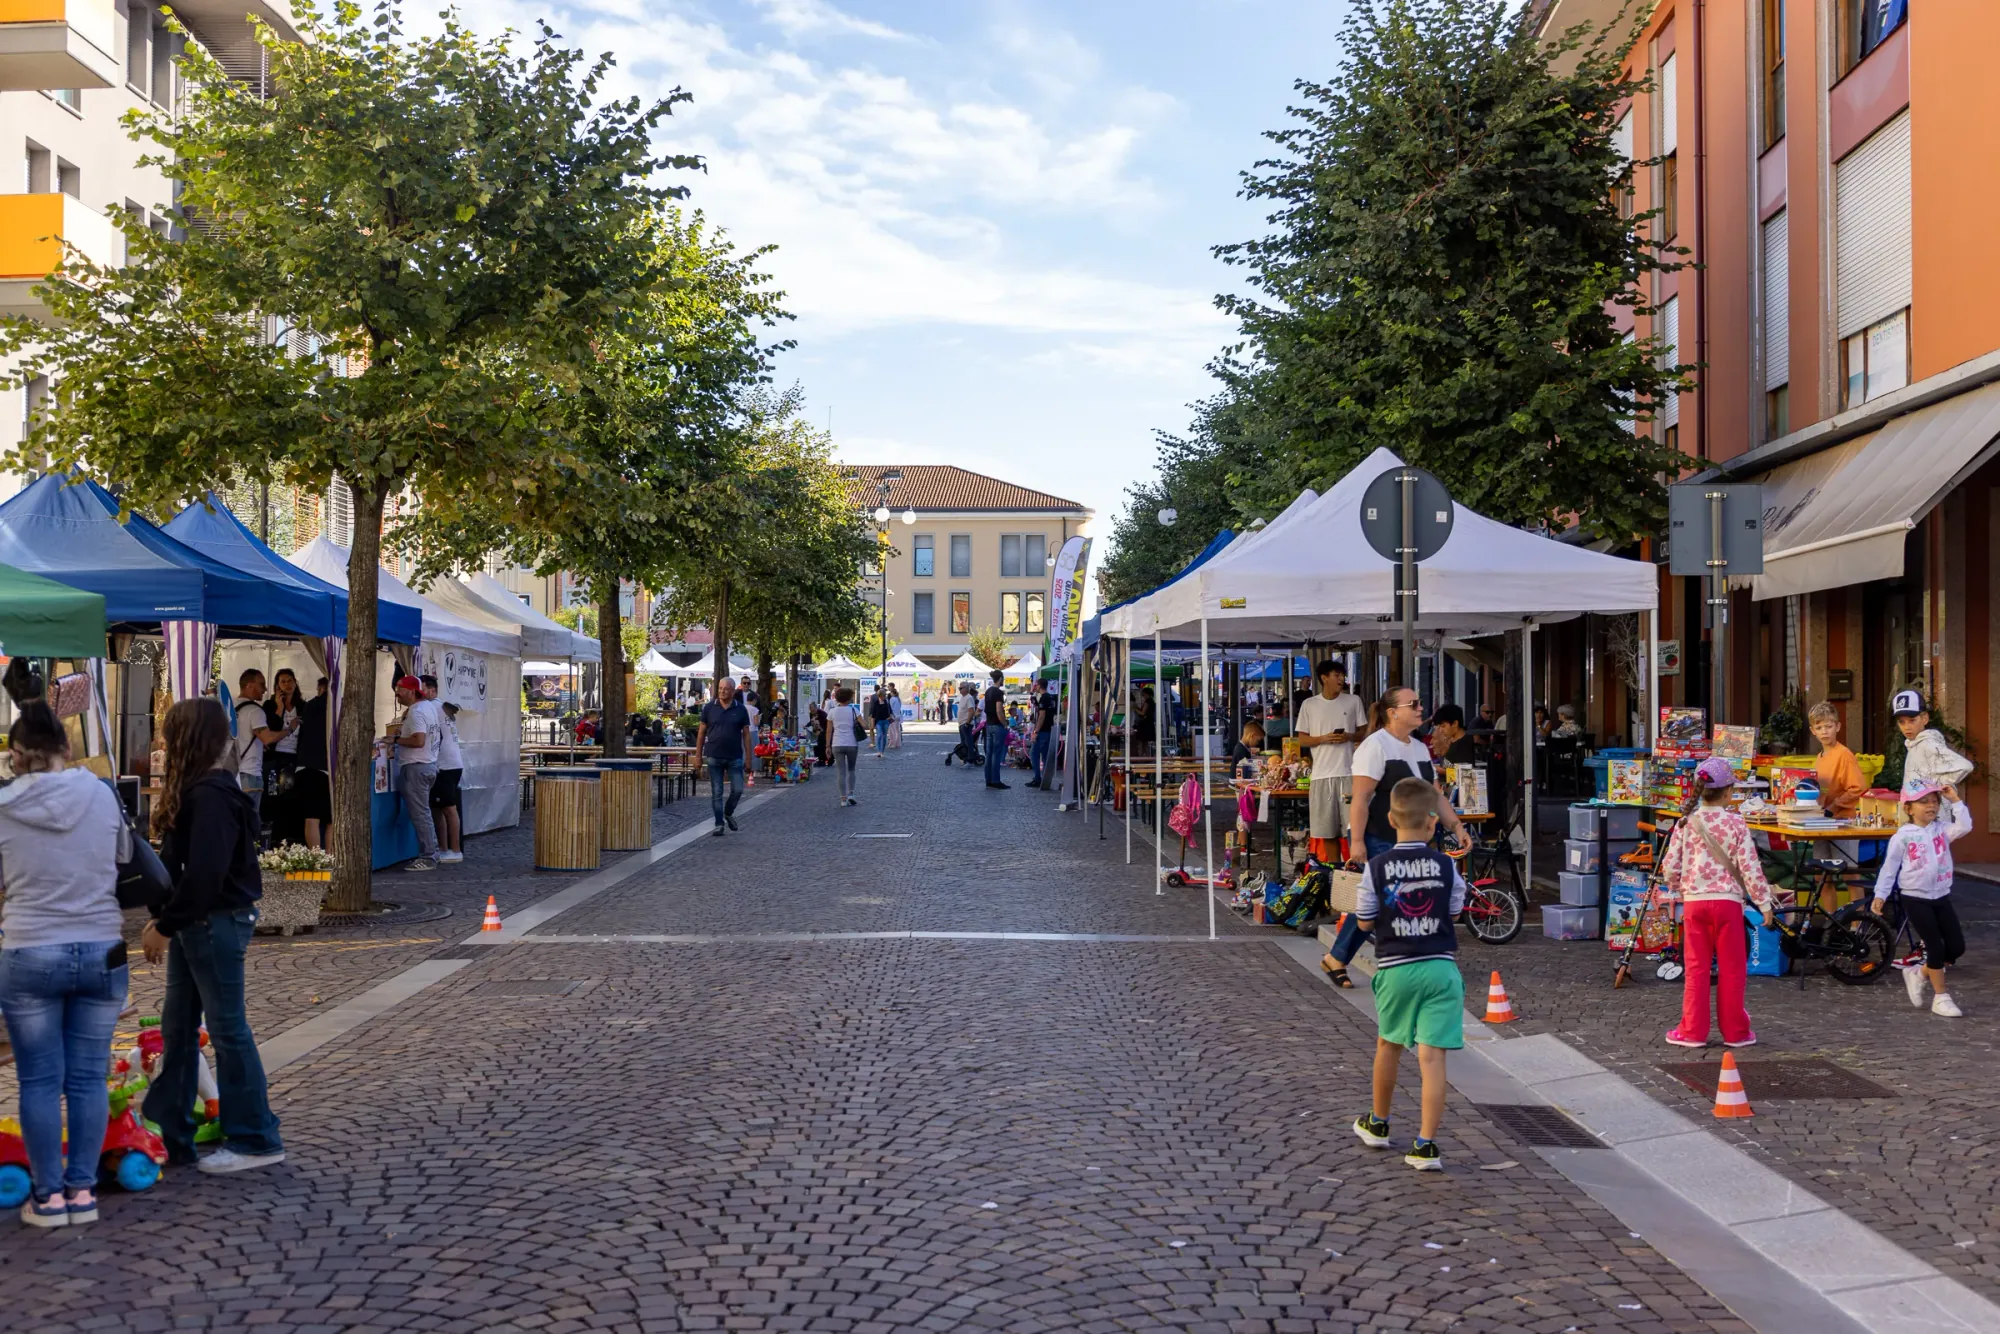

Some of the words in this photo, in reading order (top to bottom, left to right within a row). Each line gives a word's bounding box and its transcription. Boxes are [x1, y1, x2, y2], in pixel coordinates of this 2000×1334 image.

[1054, 578, 1064, 599] 2025
[1051, 608, 1060, 628] 1975
[1060, 612, 1069, 647] Azzano
[1384, 858, 1441, 880] POWER
[1614, 894, 1633, 903] Disney
[1391, 916, 1440, 937] TRACK
